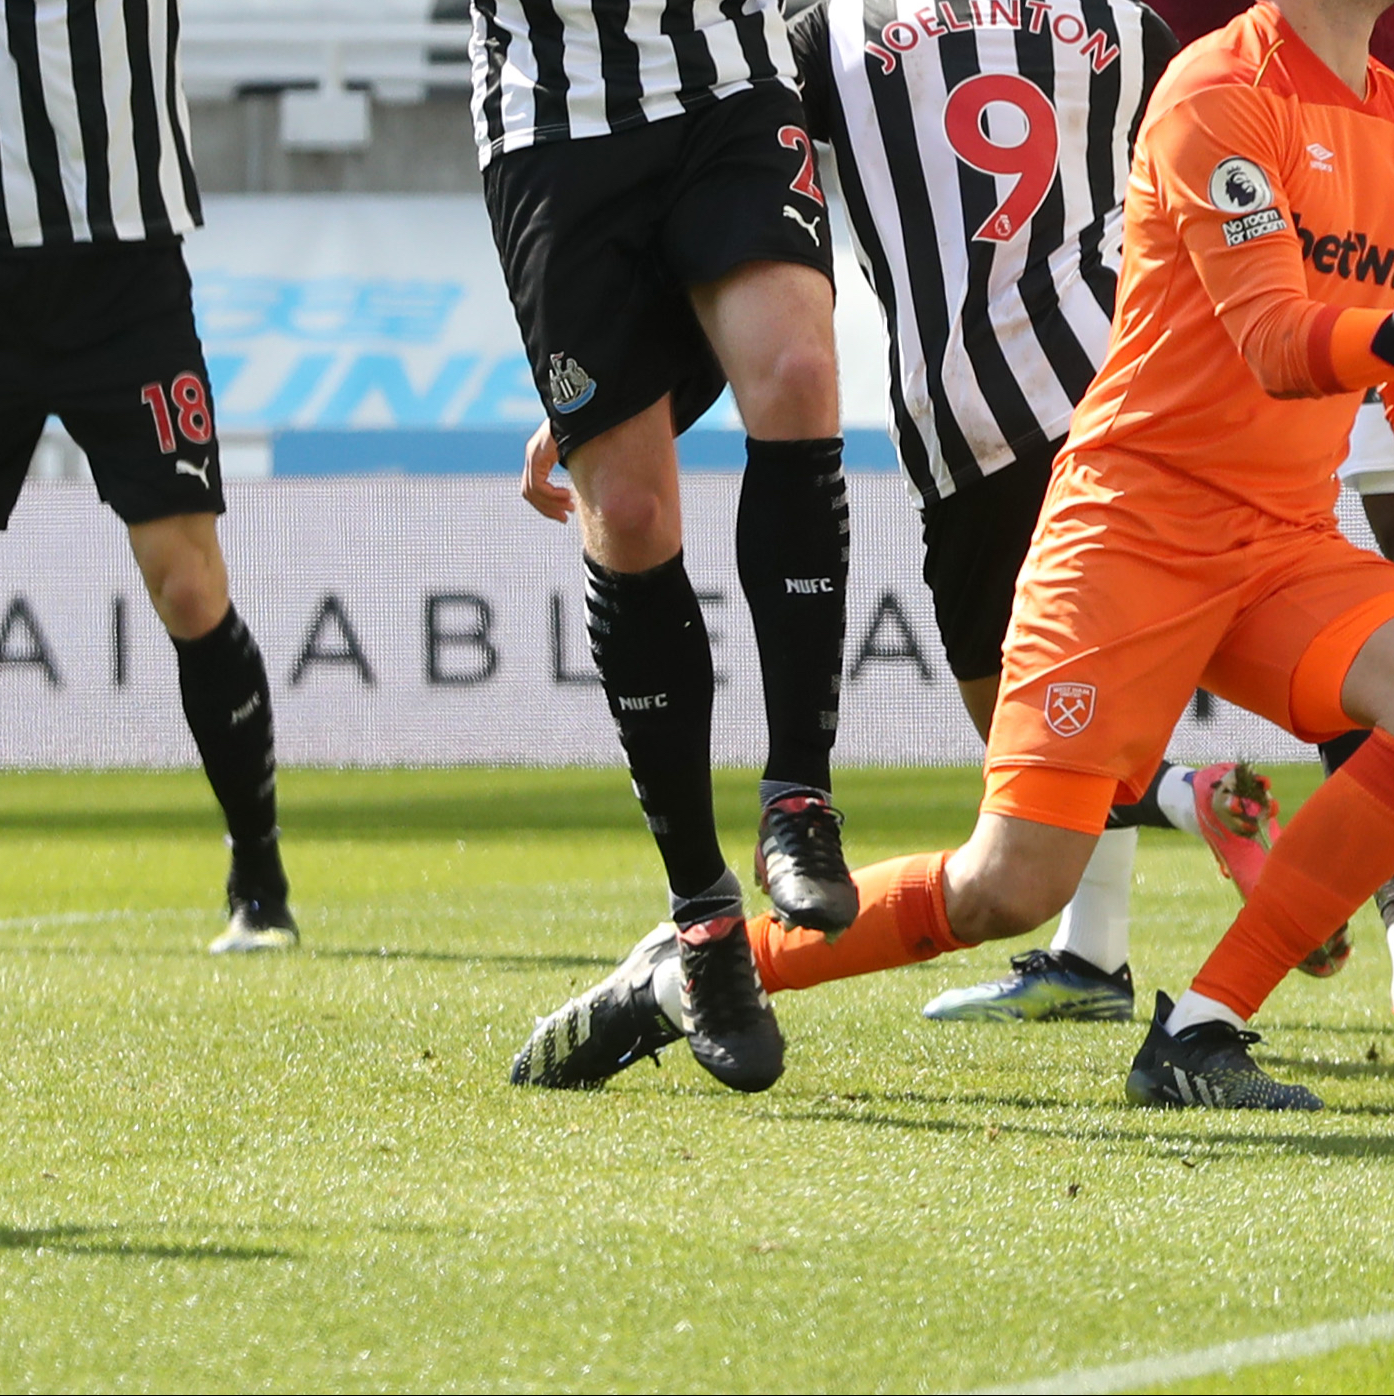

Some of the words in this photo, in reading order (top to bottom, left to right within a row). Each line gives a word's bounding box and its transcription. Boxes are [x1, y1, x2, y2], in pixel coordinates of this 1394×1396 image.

[942, 71, 1061, 244] 9
[1221, 218, 1244, 236] No
[1243, 209, 1280, 231] room
[1225, 230, 1247, 247] for
[1246, 219, 1287, 242] racism
[140, 369, 214, 455] 18
[785, 577, 835, 595] NUFC
[618, 692, 669, 711] NUFC
